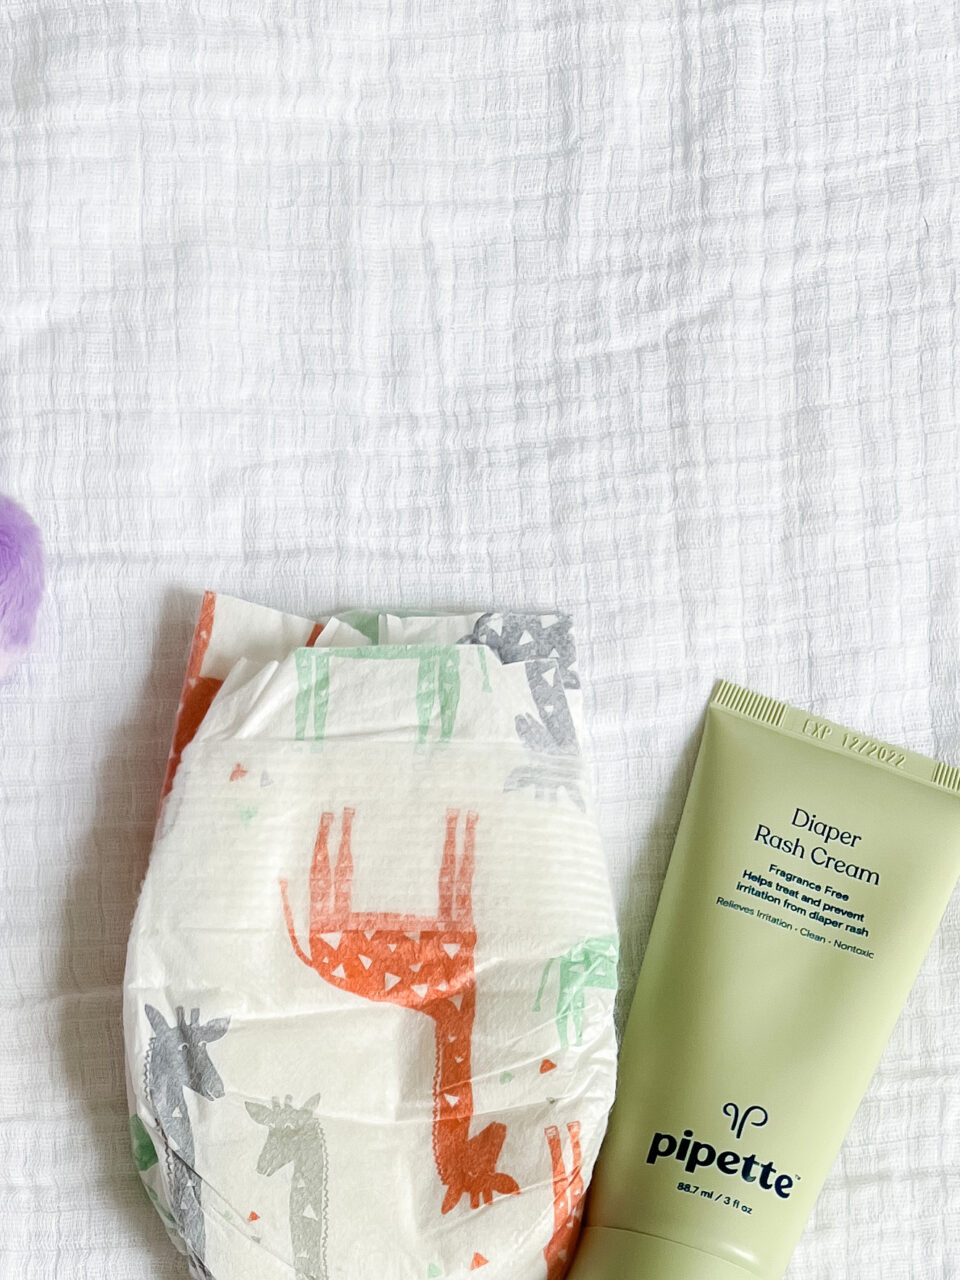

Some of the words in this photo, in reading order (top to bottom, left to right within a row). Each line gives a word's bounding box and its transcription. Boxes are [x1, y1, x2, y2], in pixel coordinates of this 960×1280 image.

[802, 718, 833, 740] EXP
[842, 732, 907, 770] 12/2022
[791, 808, 862, 847] Diaper
[754, 824, 805, 859] Rash
[810, 846, 880, 886] Cream
[742, 869, 773, 887] Helps
[775, 882, 800, 899] treat
[801, 894, 822, 908] and
[822, 902, 865, 922] prevent
[768, 863, 822, 892] Fragrance
[824, 885, 850, 902] Free
[716, 896, 755, 916] Relieves
[756, 909, 793, 931] Irritation
[799, 927, 826, 944] Clean
[833, 939, 875, 960] Nontoxic
[783, 898, 807, 917] from
[808, 910, 844, 929] diaper
[844, 924, 869, 938] rash
[646, 1129, 794, 1199] pipette
[677, 1181, 700, 1195] 88.7
[700, 1189, 714, 1200] ml
[723, 1196, 731, 1206] 3
[732, 1198, 741, 1209] fl
[741, 1204, 753, 1215] oz
